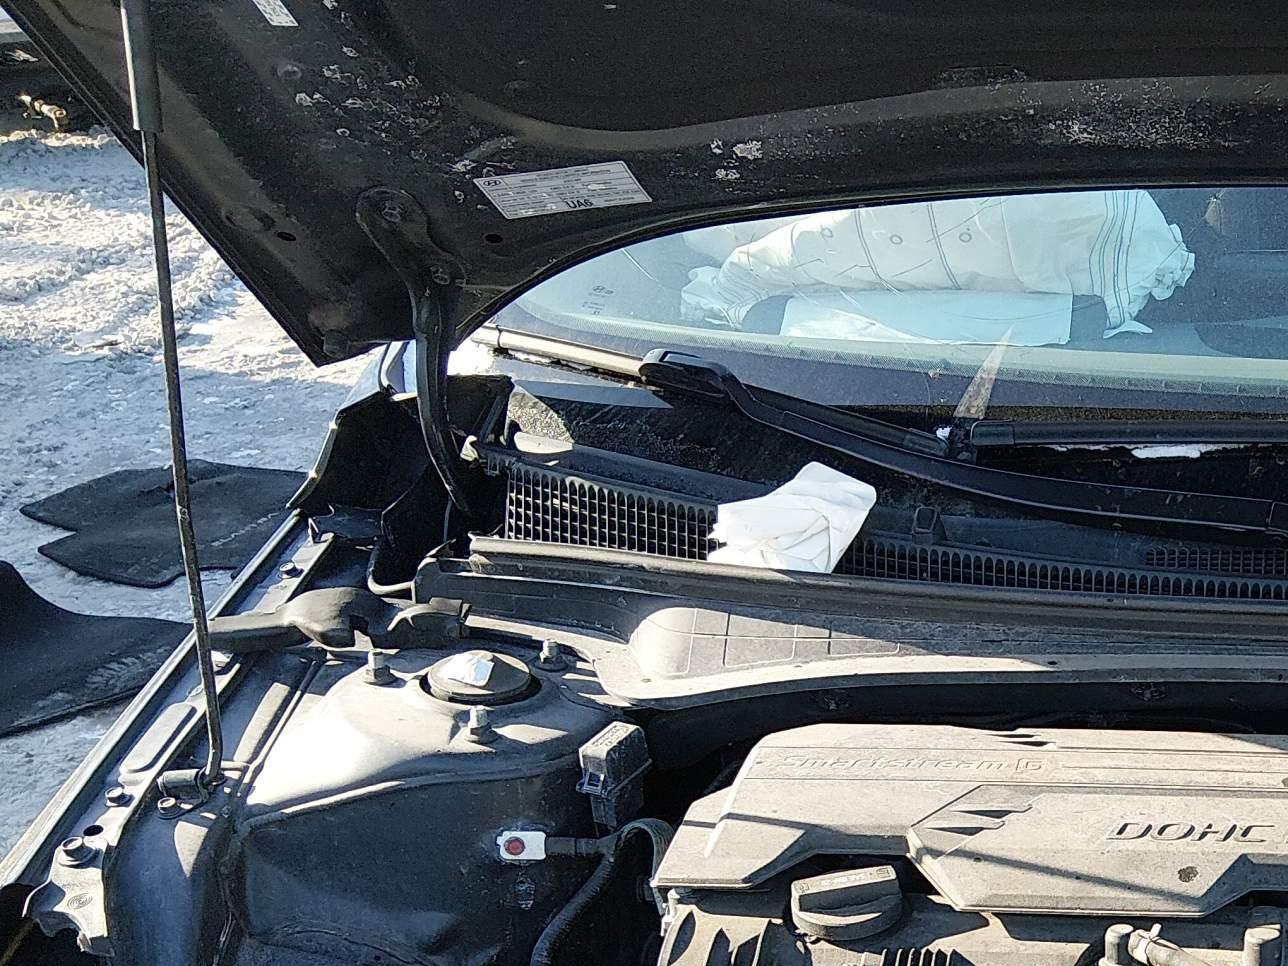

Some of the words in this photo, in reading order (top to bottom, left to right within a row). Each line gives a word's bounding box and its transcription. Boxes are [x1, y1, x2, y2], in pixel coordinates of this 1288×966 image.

[565, 199, 594, 210] UA6
[783, 755, 1009, 770] Smartstream
[1105, 822, 1276, 843] DOHC
